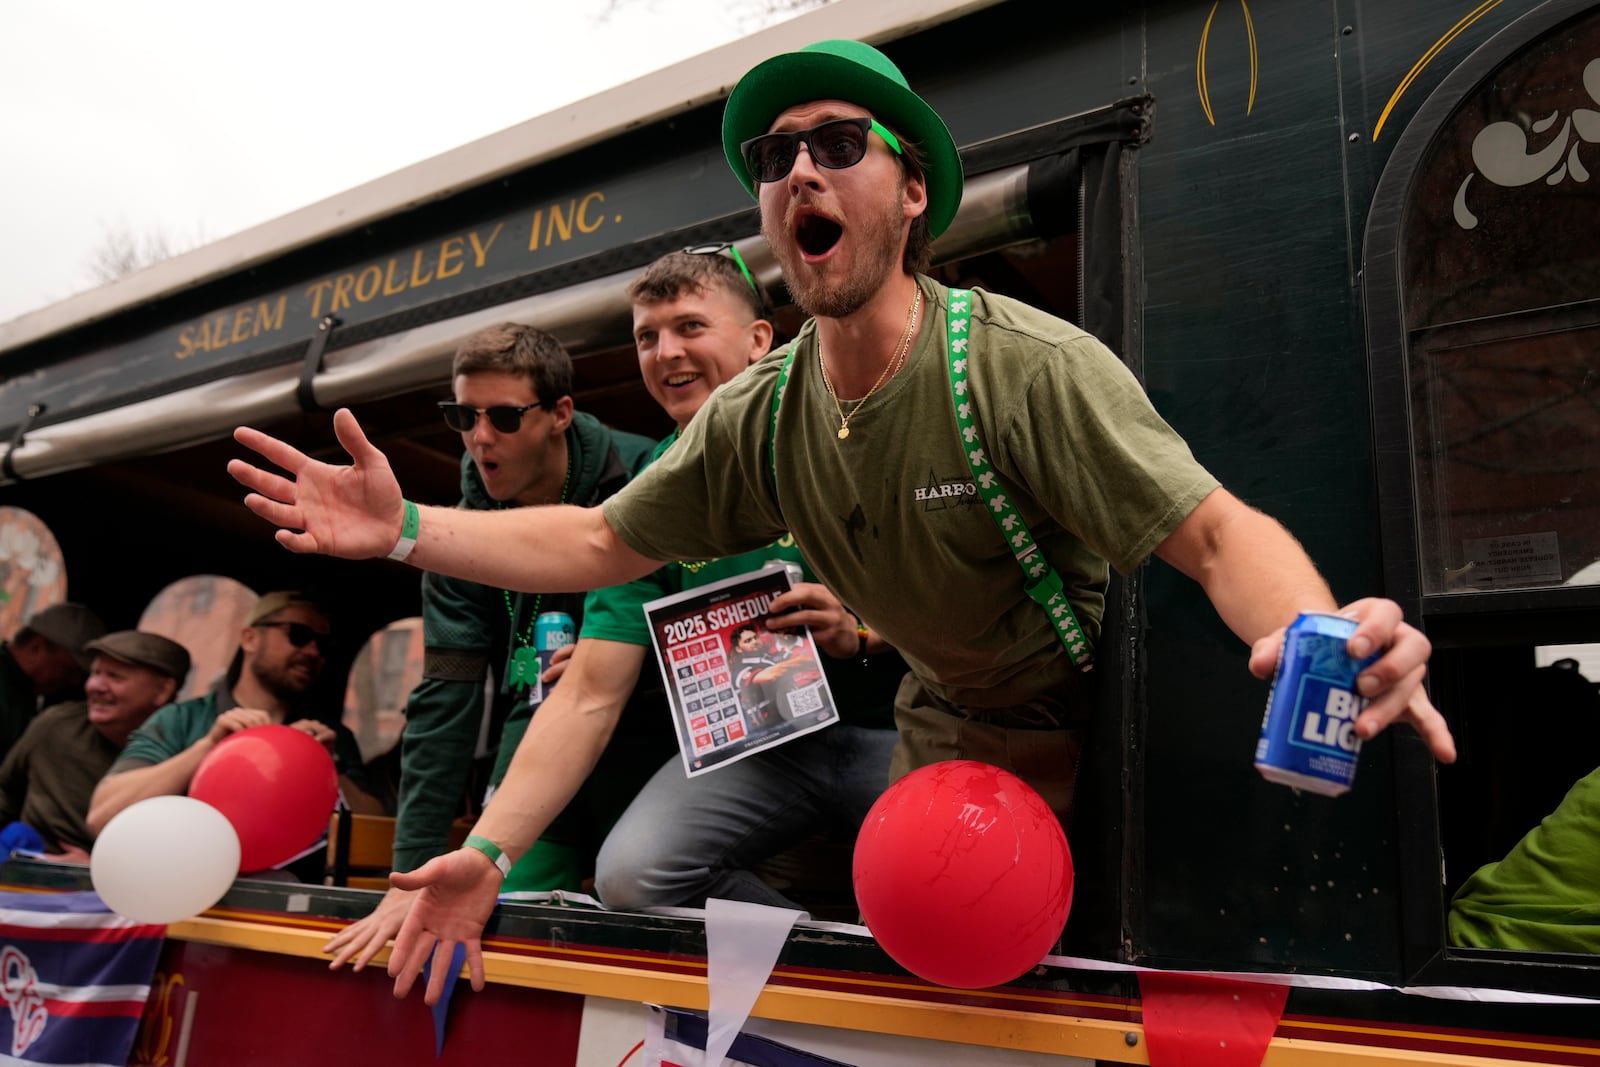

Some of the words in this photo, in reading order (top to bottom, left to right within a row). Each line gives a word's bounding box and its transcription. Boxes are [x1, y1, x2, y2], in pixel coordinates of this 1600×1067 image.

[174, 295, 287, 360] SALEM
[305, 222, 504, 318] TROLLEY
[528, 191, 624, 252] INC.
[914, 483, 978, 501] HARBO
[663, 614, 707, 645] 2025
[1325, 687, 1369, 721] BU
[1302, 712, 1363, 753] LIG
